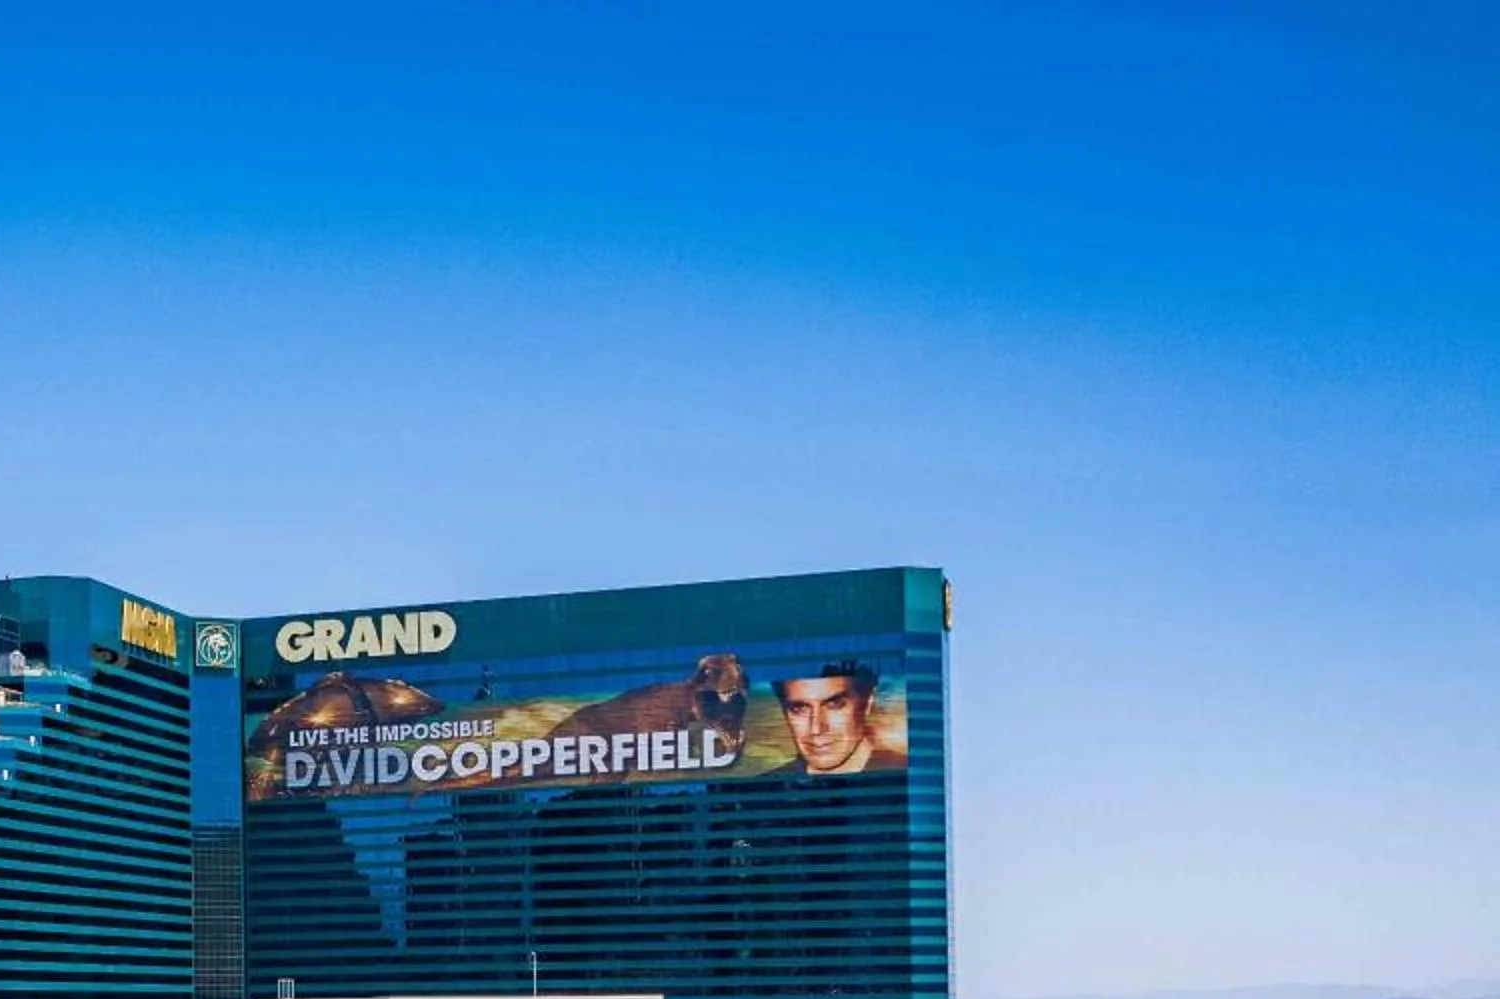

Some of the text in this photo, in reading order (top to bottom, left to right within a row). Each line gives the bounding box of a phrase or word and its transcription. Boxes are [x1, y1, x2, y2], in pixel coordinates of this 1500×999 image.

[276, 611, 457, 662] GRAND
[289, 719, 494, 747] LIVE THE IMPOSSIBLE
